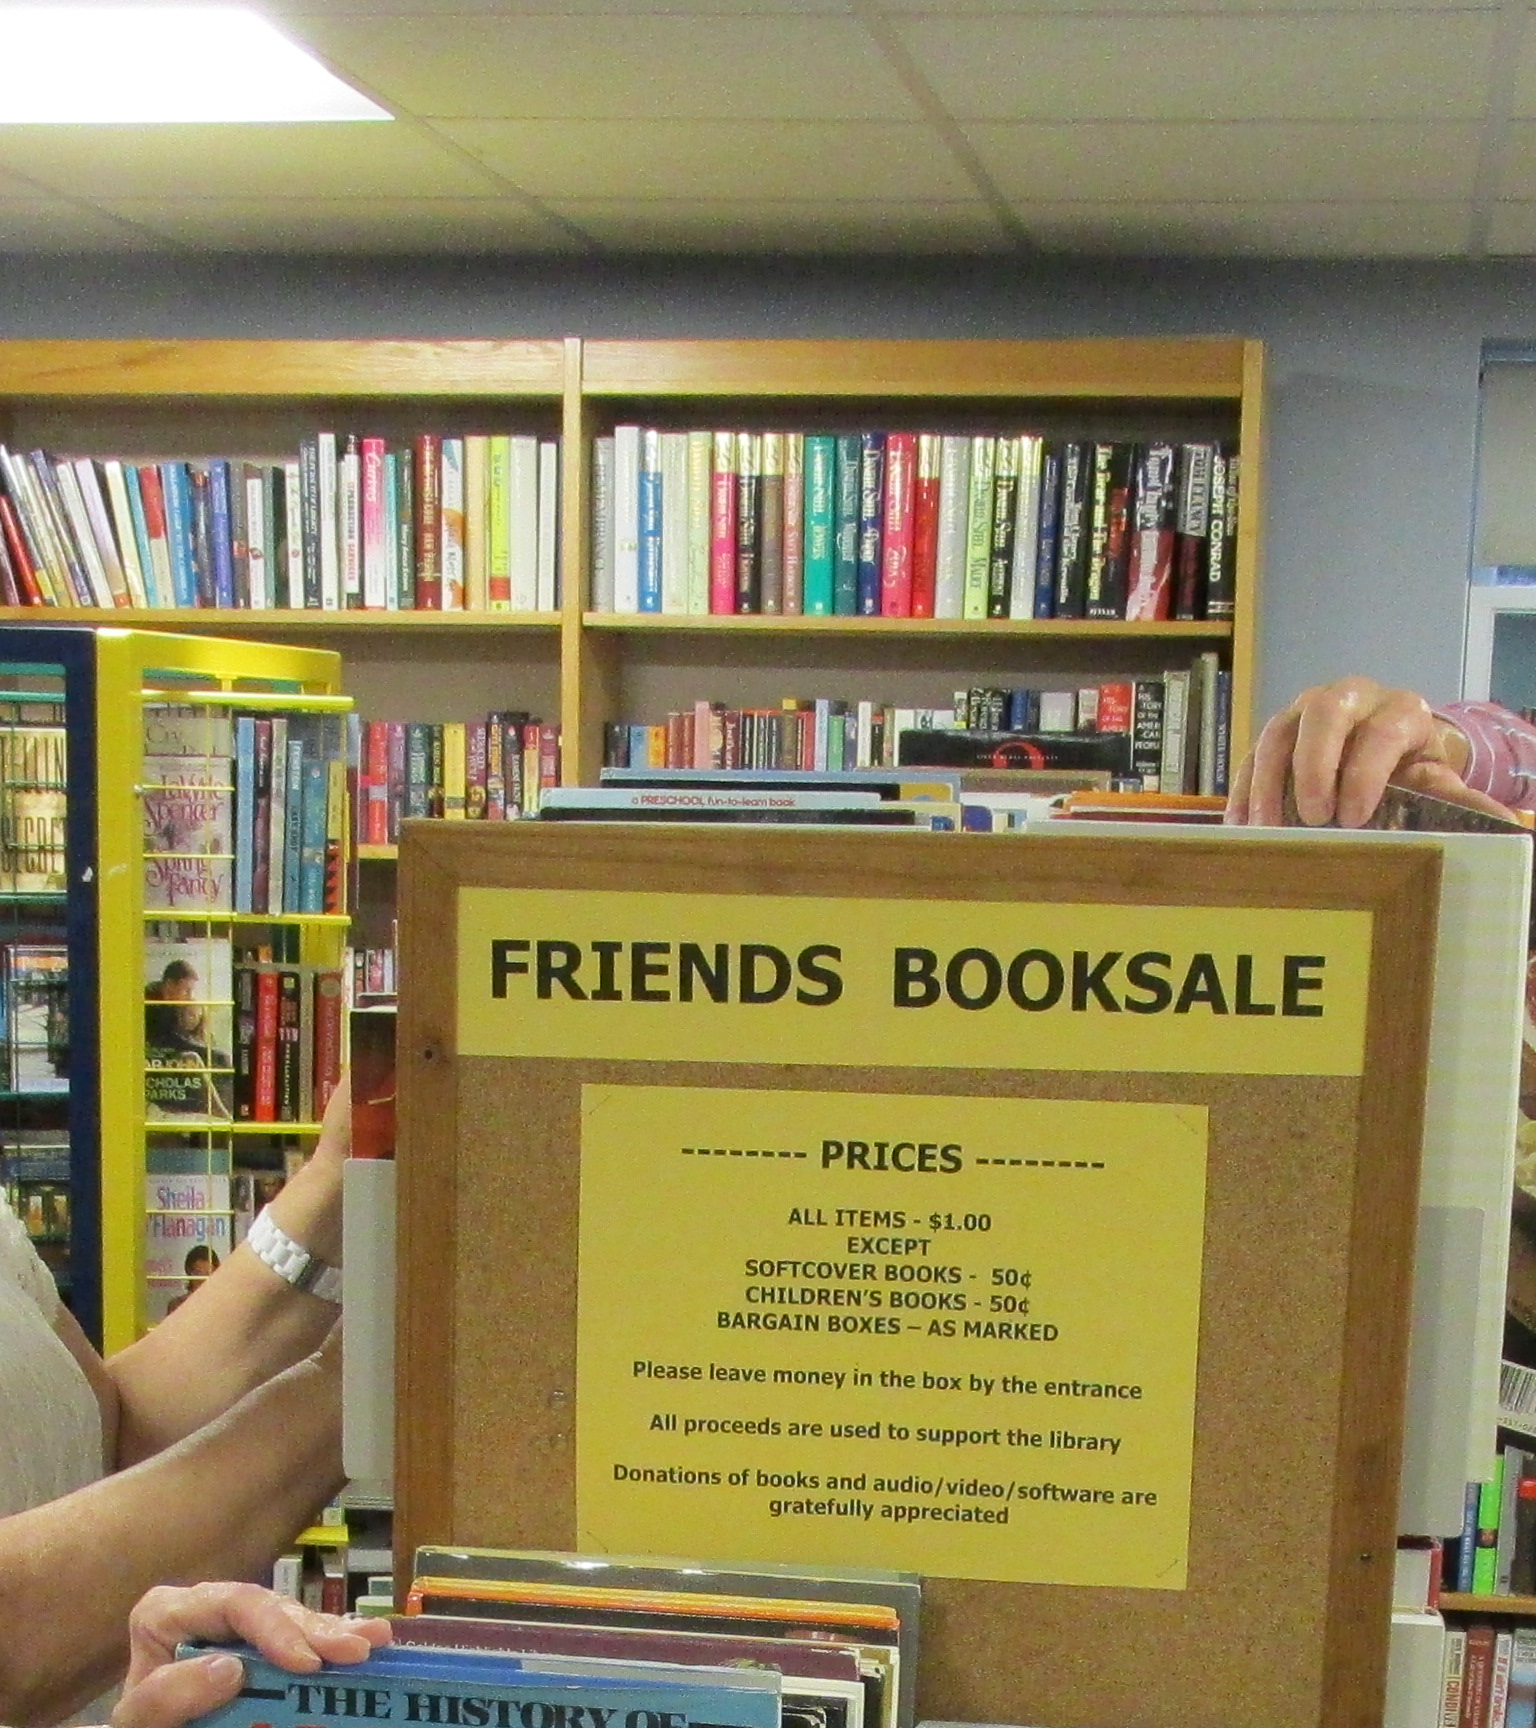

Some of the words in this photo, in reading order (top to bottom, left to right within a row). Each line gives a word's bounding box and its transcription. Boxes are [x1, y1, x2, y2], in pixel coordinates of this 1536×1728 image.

[1211, 455, 1226, 515] JOSEPH
[1209, 519, 1224, 582] CONRAD
[1089, 557, 1107, 601] Dragon
[492, 940, 843, 1006] FRIENDS
[894, 948, 1325, 1017] BOOKSALE
[822, 1140, 962, 1174] PRICES
[156, 1186, 205, 1210] Sheila
[788, 1207, 830, 1227] ALL
[836, 1209, 905, 1228] ITEMS
[929, 1212, 991, 1232] $1.00
[848, 1237, 931, 1256] EXCEPT
[745, 1259, 877, 1280] SOFTCOVER
[885, 1265, 961, 1284] BOOKS
[992, 1268, 1032, 1289] 50¢
[890, 1291, 966, 1311] BOOKS
[990, 1295, 1029, 1316] 50¢
[718, 1311, 819, 1331] BARGAIN
[828, 1315, 900, 1335] BOXES
[928, 1319, 956, 1337] AS
[964, 1321, 1058, 1341] MARKED
[633, 1361, 702, 1380] Please
[710, 1363, 766, 1382] leave
[774, 1370, 846, 1389] money
[854, 1368, 872, 1386] in
[880, 1370, 915, 1388] the
[923, 1371, 961, 1390] box
[970, 1374, 995, 1396] by
[1002, 1375, 1037, 1394] the
[1044, 1380, 1142, 1399] entrance
[650, 1414, 676, 1431] All
[684, 1417, 781, 1436] proceeds
[788, 1423, 822, 1437] are
[831, 1422, 880, 1439] used
[888, 1424, 909, 1440] to
[917, 1428, 1001, 1447] support
[1007, 1429, 1042, 1447] the
[1050, 1431, 1121, 1455] library
[614, 1464, 721, 1485] Donations
[728, 1469, 750, 1486] of
[757, 1469, 819, 1489] books
[826, 1473, 866, 1490] and
[874, 1475, 1114, 1504] audio/video/software
[1121, 1491, 1156, 1506] are
[769, 1498, 874, 1521] gratefully
[881, 1504, 1008, 1524] appreciated
[287, 1682, 393, 1720] THE
